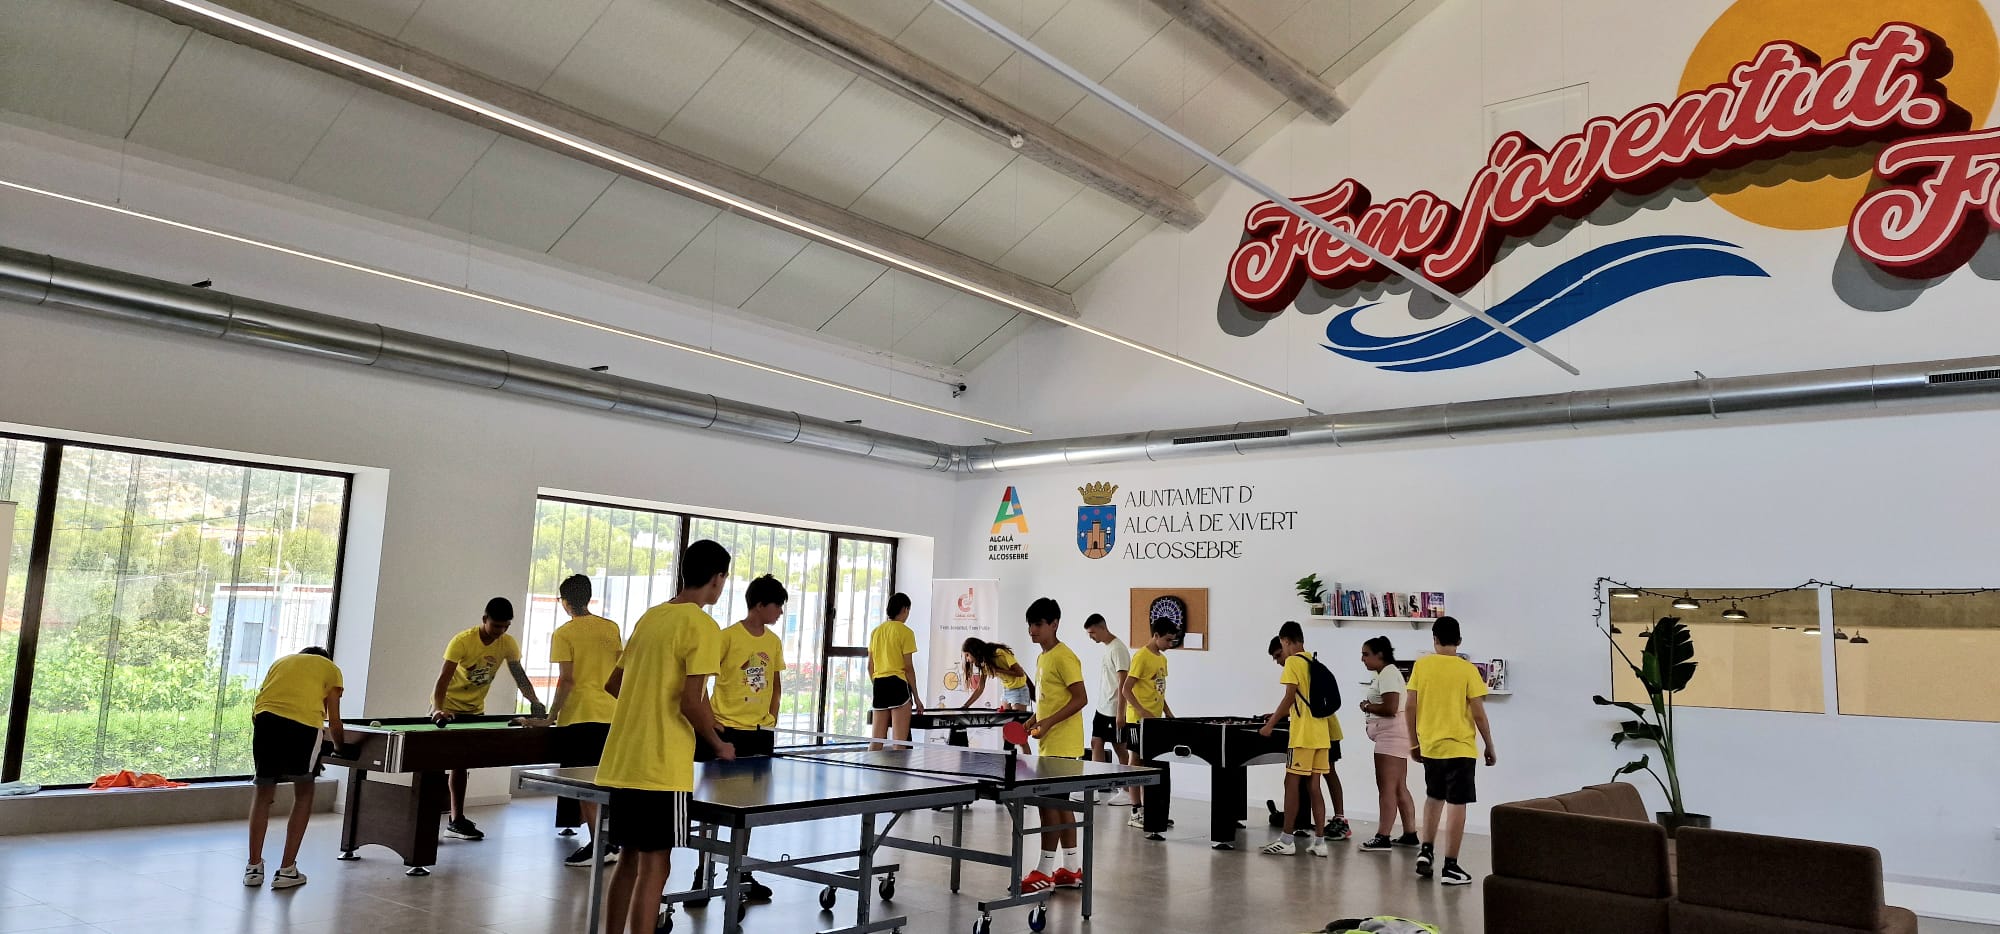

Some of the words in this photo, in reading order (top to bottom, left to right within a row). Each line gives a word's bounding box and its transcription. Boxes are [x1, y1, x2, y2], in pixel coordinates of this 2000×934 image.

[1227, 177, 1452, 305] Fem
[1420, 20, 1942, 286] joventut.
[1847, 126, 2000, 270] F
[1124, 486, 1234, 508] AJUNTAMENT
[1123, 511, 1194, 534] ALCALÀ
[1199, 513, 1223, 532] DE
[1228, 511, 1298, 531] XIVERT
[988, 544, 998, 552] DE
[988, 553, 1029, 561] ALCOSSEBRE
[1122, 540, 1243, 560] ALCOSSEBRE
